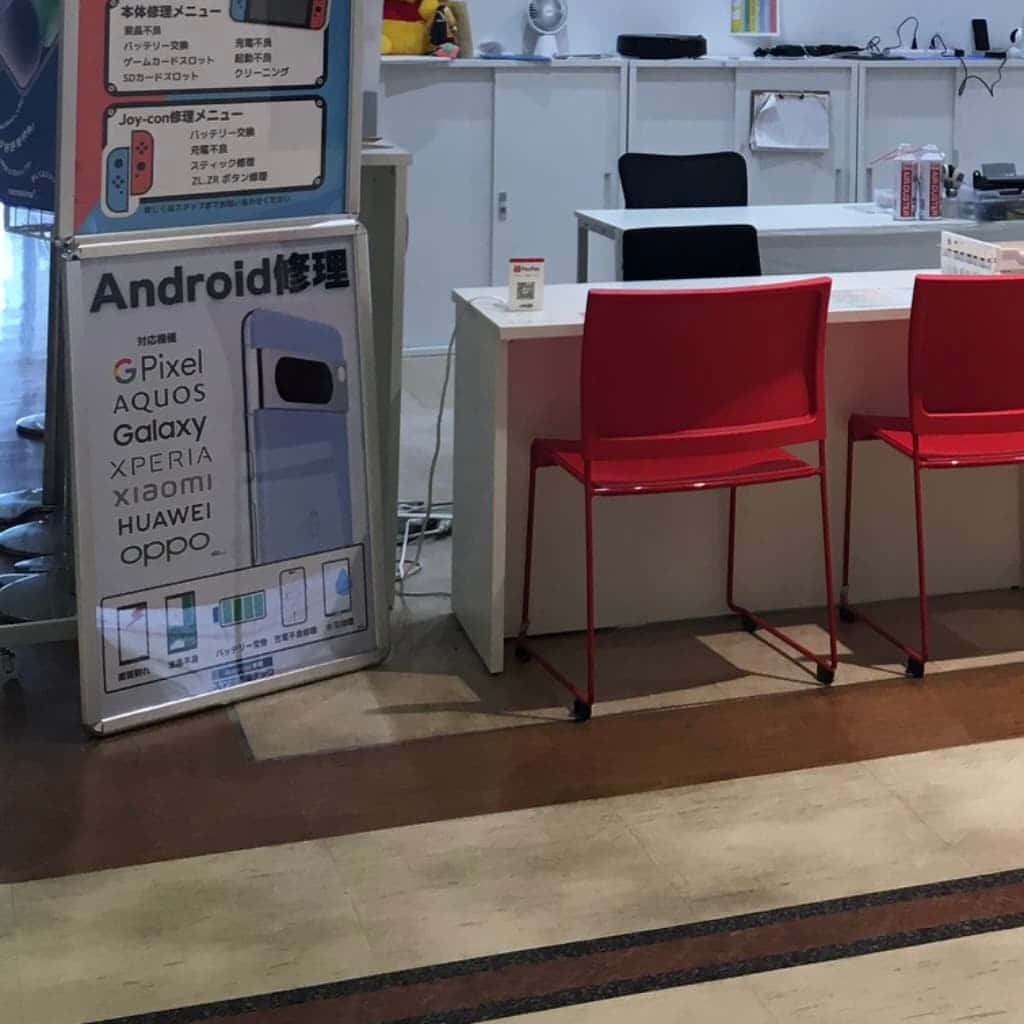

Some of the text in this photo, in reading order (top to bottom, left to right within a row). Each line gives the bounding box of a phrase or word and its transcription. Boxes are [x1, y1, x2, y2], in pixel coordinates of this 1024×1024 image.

[121, 5, 222, 19] 本体修理メニュー
[123, 41, 189, 52] バッテリー交換
[235, 38, 272, 49] 充電不良
[123, 55, 214, 68] ゲームカードスロット
[235, 52, 272, 64] 起動不良
[123, 71, 199, 82] SDカードスロット
[235, 67, 289, 79] クリーニング
[119, 110, 243, 127] Joy-con修理メニュー
[190, 128, 256, 140] バッテリー交換
[190, 157, 256, 171] スティック修理
[89, 249, 350, 313] Android修理
[113, 384, 206, 414] AQUOS
[113, 416, 207, 447] Galaxy
[110, 446, 213, 479] XPERIA
[113, 474, 212, 507] xiaomi
[118, 503, 212, 536] HUAWEI
[120, 532, 211, 566] oppo
